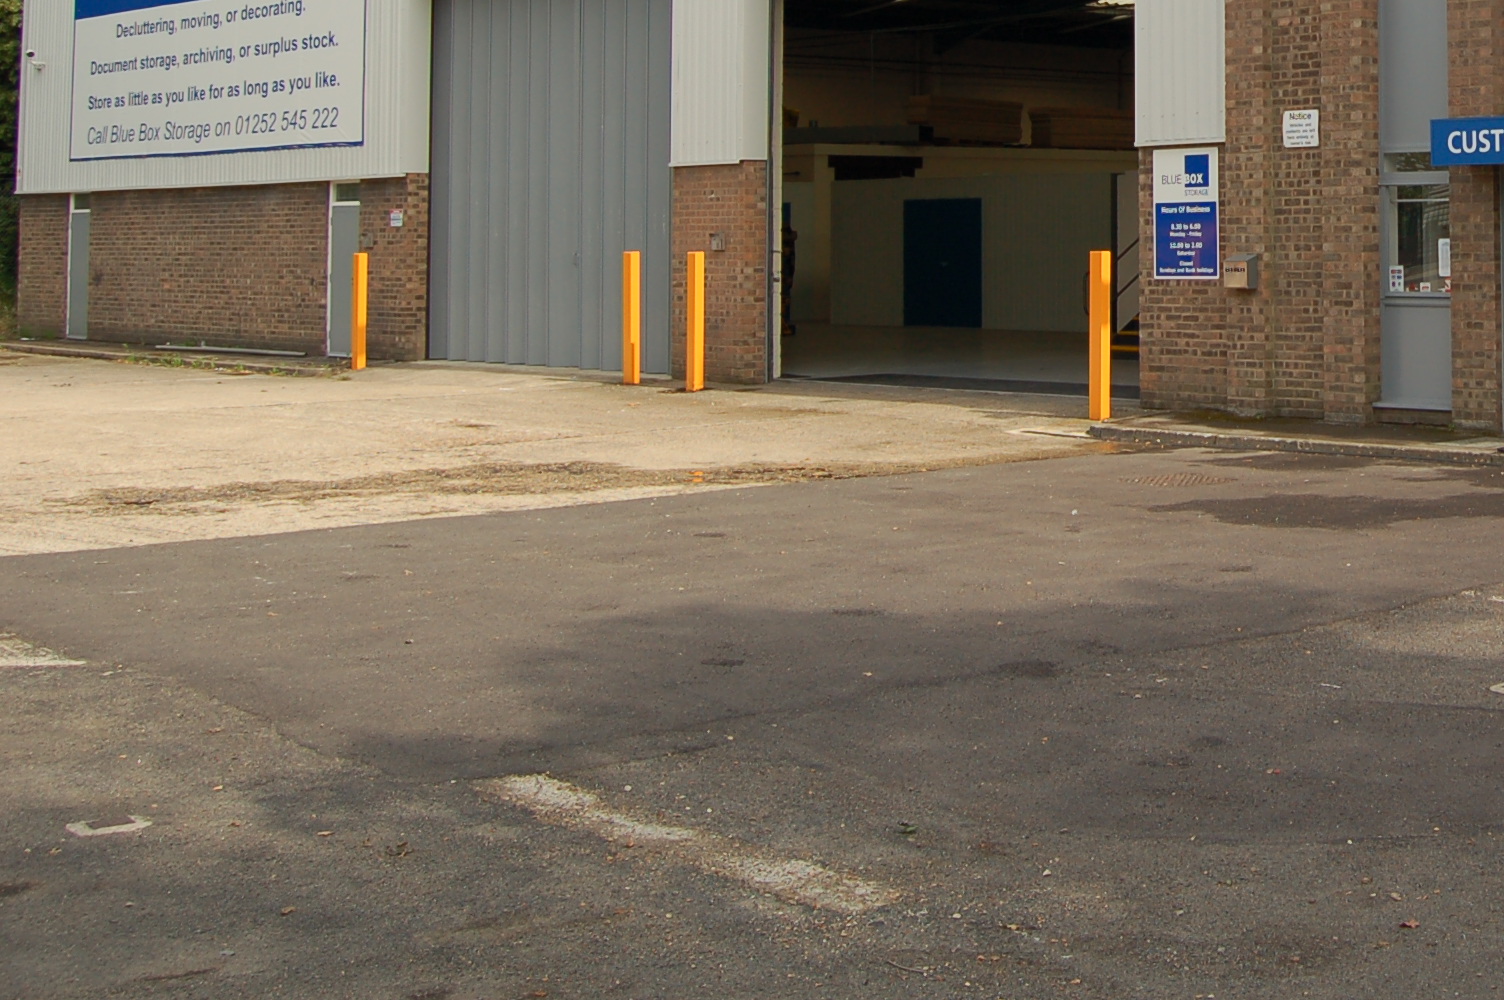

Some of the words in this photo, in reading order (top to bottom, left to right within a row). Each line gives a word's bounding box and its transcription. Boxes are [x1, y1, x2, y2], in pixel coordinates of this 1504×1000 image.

[116, 17, 177, 39] Decluttering,
[180, 12, 223, 31] moving,
[226, 10, 238, 24] or
[90, 56, 138, 76] Document
[139, 50, 180, 71] storage,
[182, 42, 236, 65] archiving,
[239, 43, 251, 58] or
[254, 36, 298, 58] surplus
[301, 31, 339, 51] stock.
[88, 96, 112, 111] Store
[114, 94, 126, 108] as
[127, 88, 149, 107] little
[151, 91, 163, 105] as
[165, 88, 185, 108] you
[187, 85, 206, 101] like
[209, 83, 225, 99] for
[227, 83, 240, 97] as
[243, 80, 269, 98] long
[271, 78, 286, 93] as
[288, 74, 312, 94] you
[314, 71, 340, 89] like.
[87, 125, 108, 145] Call
[110, 122, 135, 143] Blue
[139, 121, 161, 142] Box
[163, 119, 211, 144] Storage
[215, 119, 231, 136] on
[235, 111, 277, 136] 01252
[281, 108, 307, 131] 545
[311, 106, 339, 130] 222
[1161, 174, 1182, 185] BLUE
